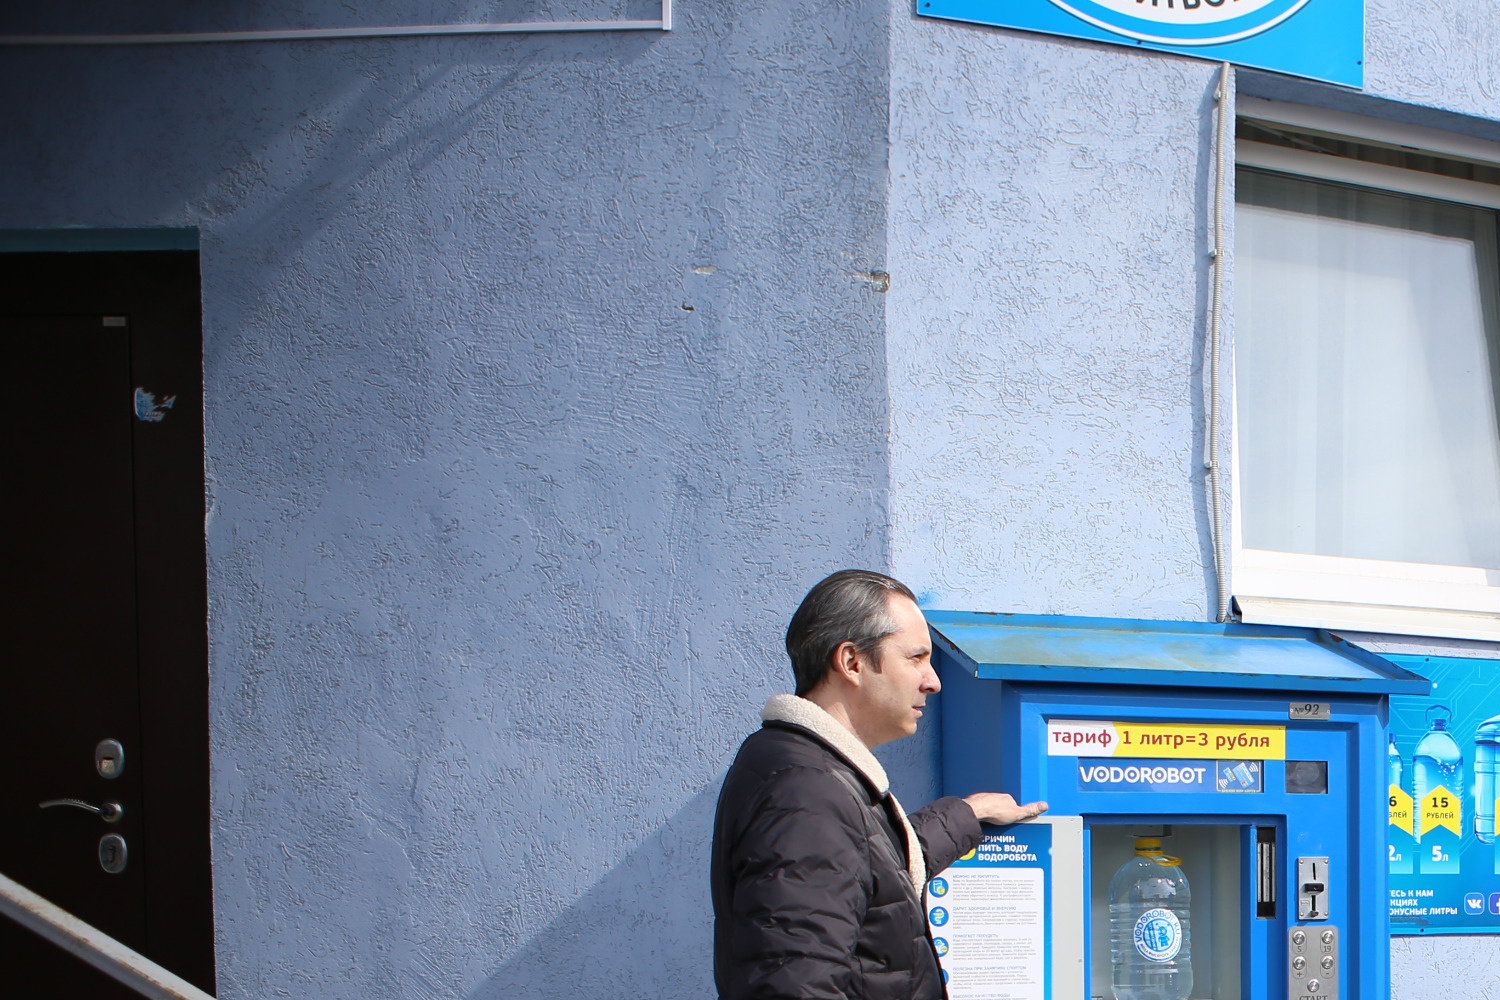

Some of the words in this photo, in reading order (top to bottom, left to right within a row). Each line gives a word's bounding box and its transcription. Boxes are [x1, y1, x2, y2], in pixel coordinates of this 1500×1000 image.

[1052, 729, 1112, 748] тариф
[1123, 731, 1132, 745] 1
[1140, 732, 1209, 750] литр=3
[1216, 733, 1270, 750] рубля
[1079, 765, 1207, 784] VODOROBOT
[1432, 797, 1449, 808] 15
[1389, 810, 1407, 818] БЛЕЙ
[981, 835, 1015, 843] РИЧИН
[978, 844, 1003, 852] ПИТЬ
[1004, 844, 1029, 853] ВОДУ
[978, 853, 1038, 862] ВОДОРОБОТА
[1431, 845, 1449, 862] 5л
[1390, 889, 1407, 898] ЕСЬ
[1408, 889, 1414, 897] К
[1415, 889, 1434, 897] НАМ
[1390, 898, 1418, 907] КЦИЯХ
[1429, 907, 1458, 915] ЛИТРЫ
